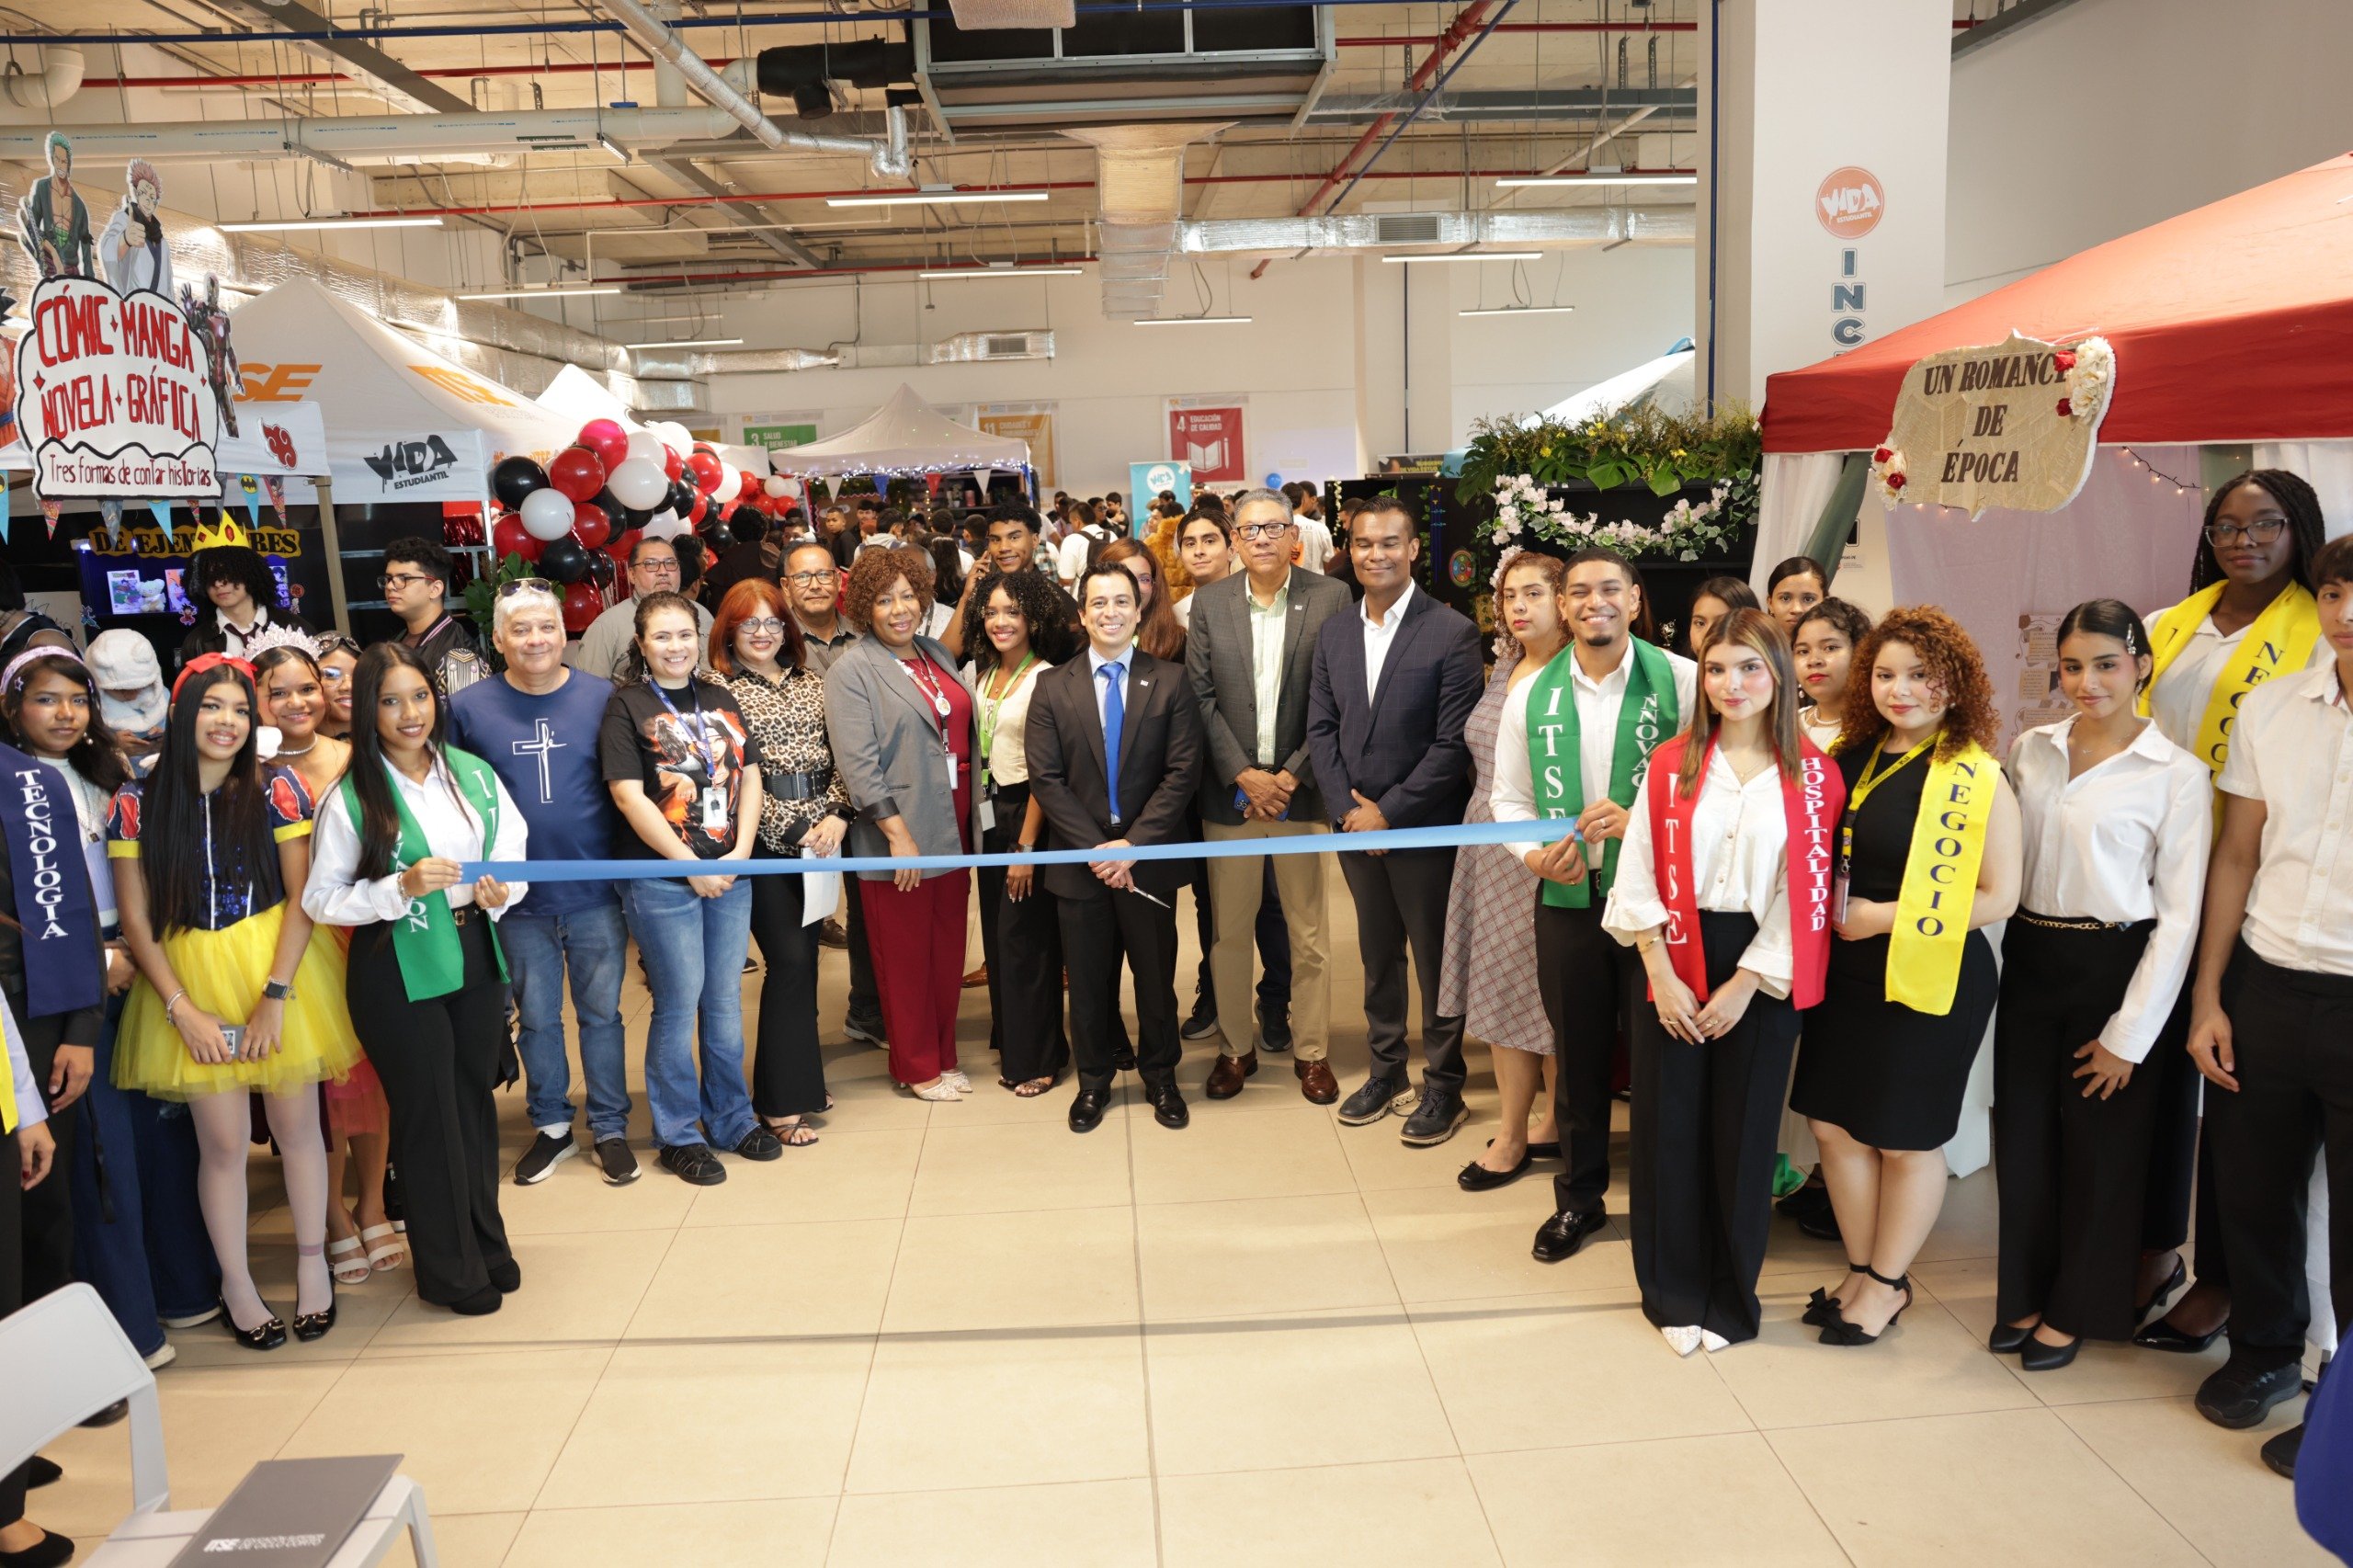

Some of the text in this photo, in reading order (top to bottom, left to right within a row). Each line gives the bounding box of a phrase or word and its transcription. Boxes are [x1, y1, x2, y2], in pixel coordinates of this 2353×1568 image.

[1821, 184, 1880, 223] VIDA
[1836, 211, 1873, 223] ESTUDIANTIL
[1831, 248, 1866, 358] INC
[35, 284, 195, 373] CÓMIC MANGA
[232, 363, 323, 402] SE
[1924, 363, 1958, 395] UN
[40, 365, 201, 442] NOVELA GRÁFICA
[1176, 414, 1222, 432] 4 EDUCACIÓN
[1972, 404, 2008, 437] DE
[763, 432, 781, 440] SALUD
[1199, 423, 1222, 431] CALIDAD
[50, 454, 76, 483] Tres
[79, 456, 116, 484] formas
[118, 459, 131, 485] de
[362, 435, 459, 494] VIDA
[1940, 438, 2020, 483] ÉPOCA
[393, 471, 449, 490] ESTUDIANTIL
[15, 768, 69, 940] TECNOLOGIA
[1665, 772, 1688, 945] ITSE
[1802, 757, 1830, 931] HOSPITALIDAD
[1916, 762, 1979, 937] NEGOCIO
